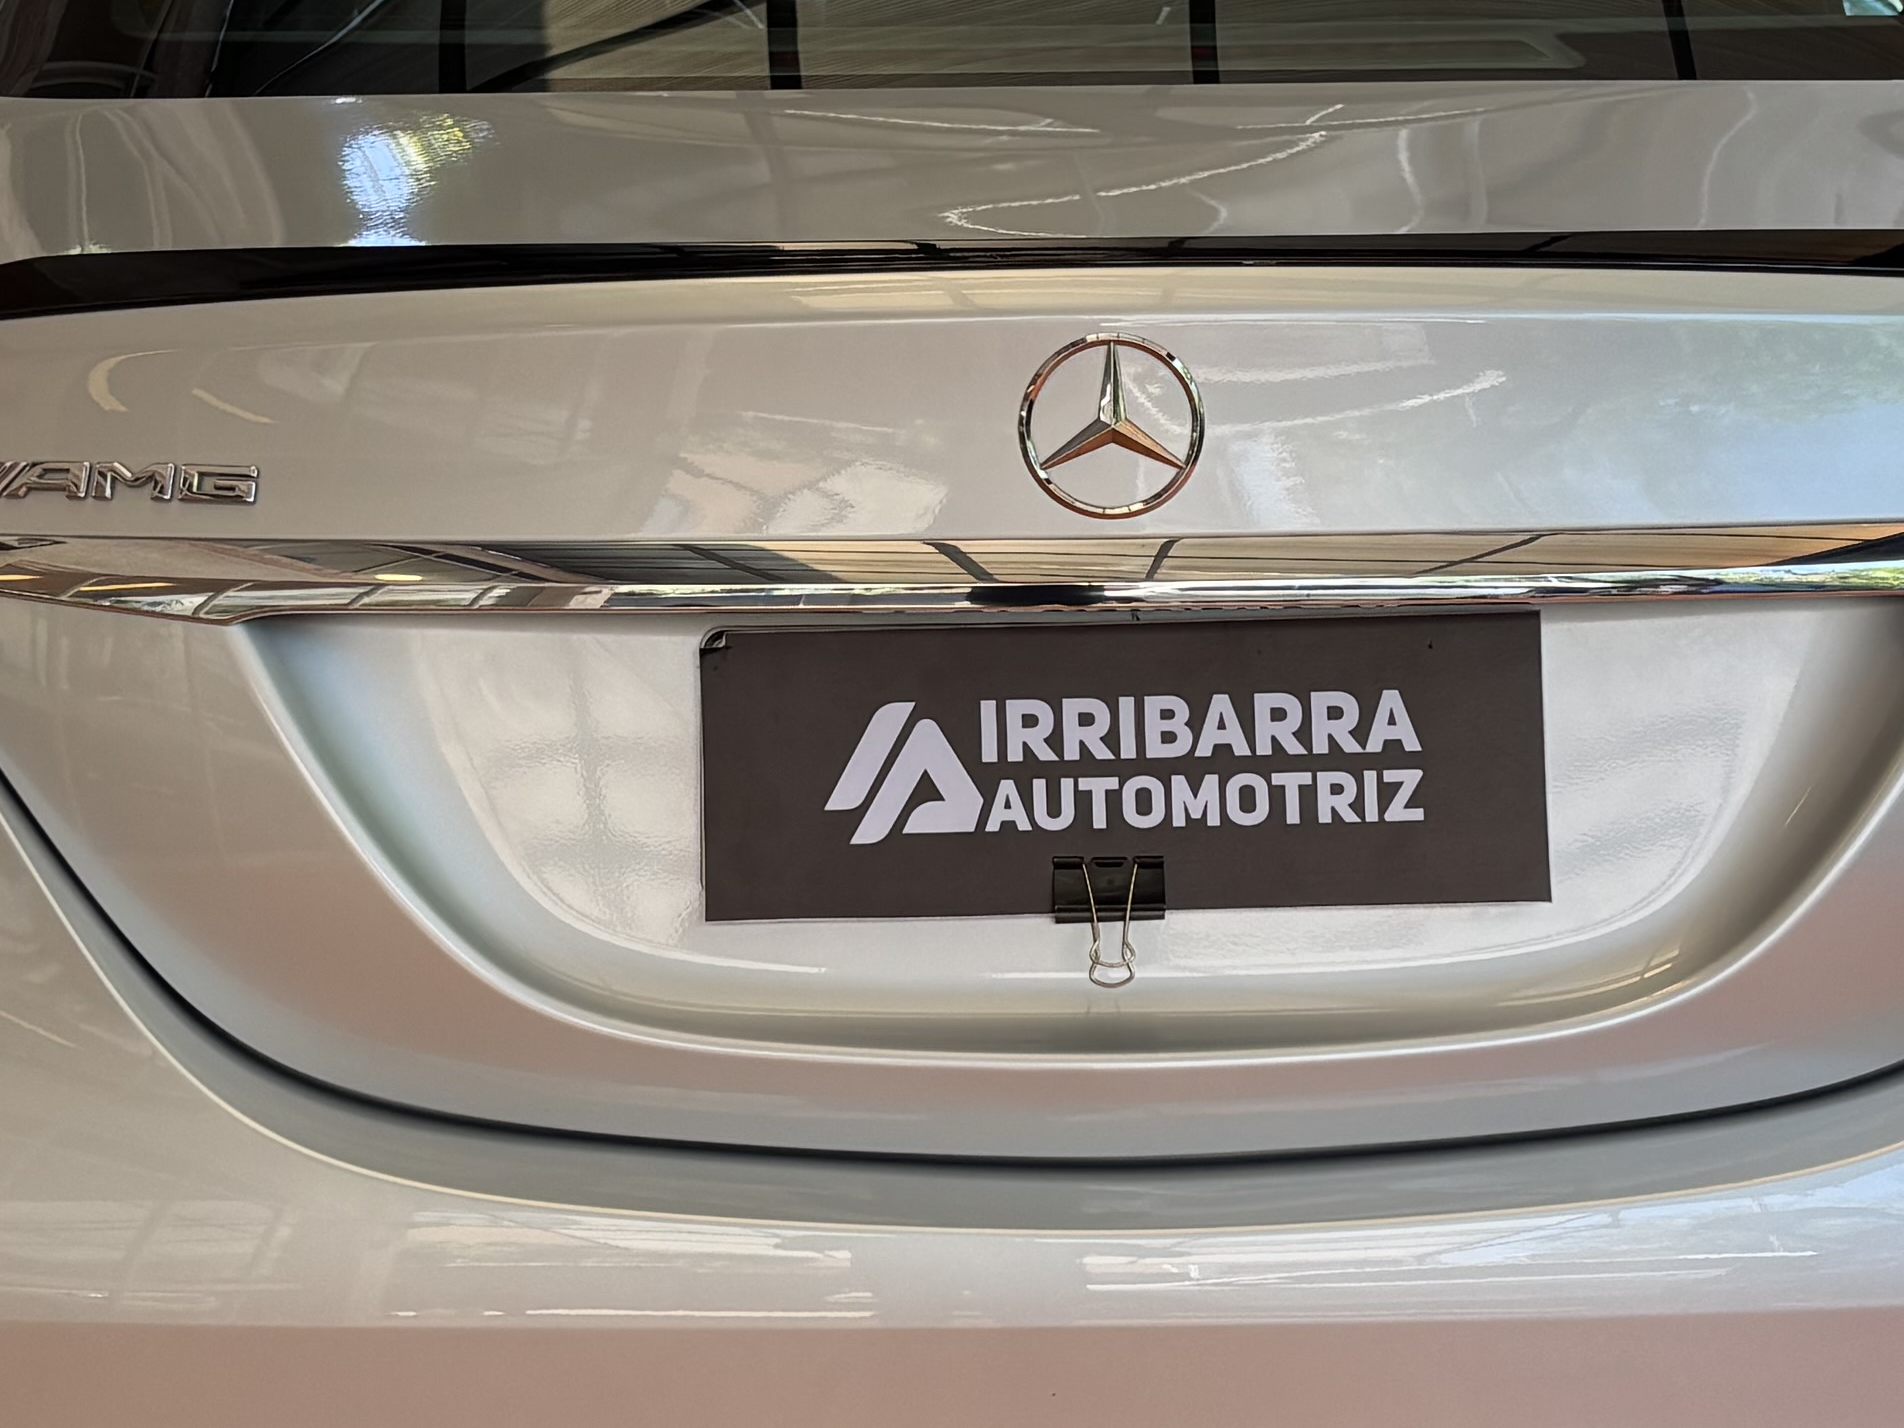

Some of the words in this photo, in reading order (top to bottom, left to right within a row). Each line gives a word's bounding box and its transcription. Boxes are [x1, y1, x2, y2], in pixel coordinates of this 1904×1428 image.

[3, 461, 259, 504] AMG
[979, 689, 1423, 763] IRRIBARRA
[983, 768, 1425, 833] AUTOMOTRIZ
